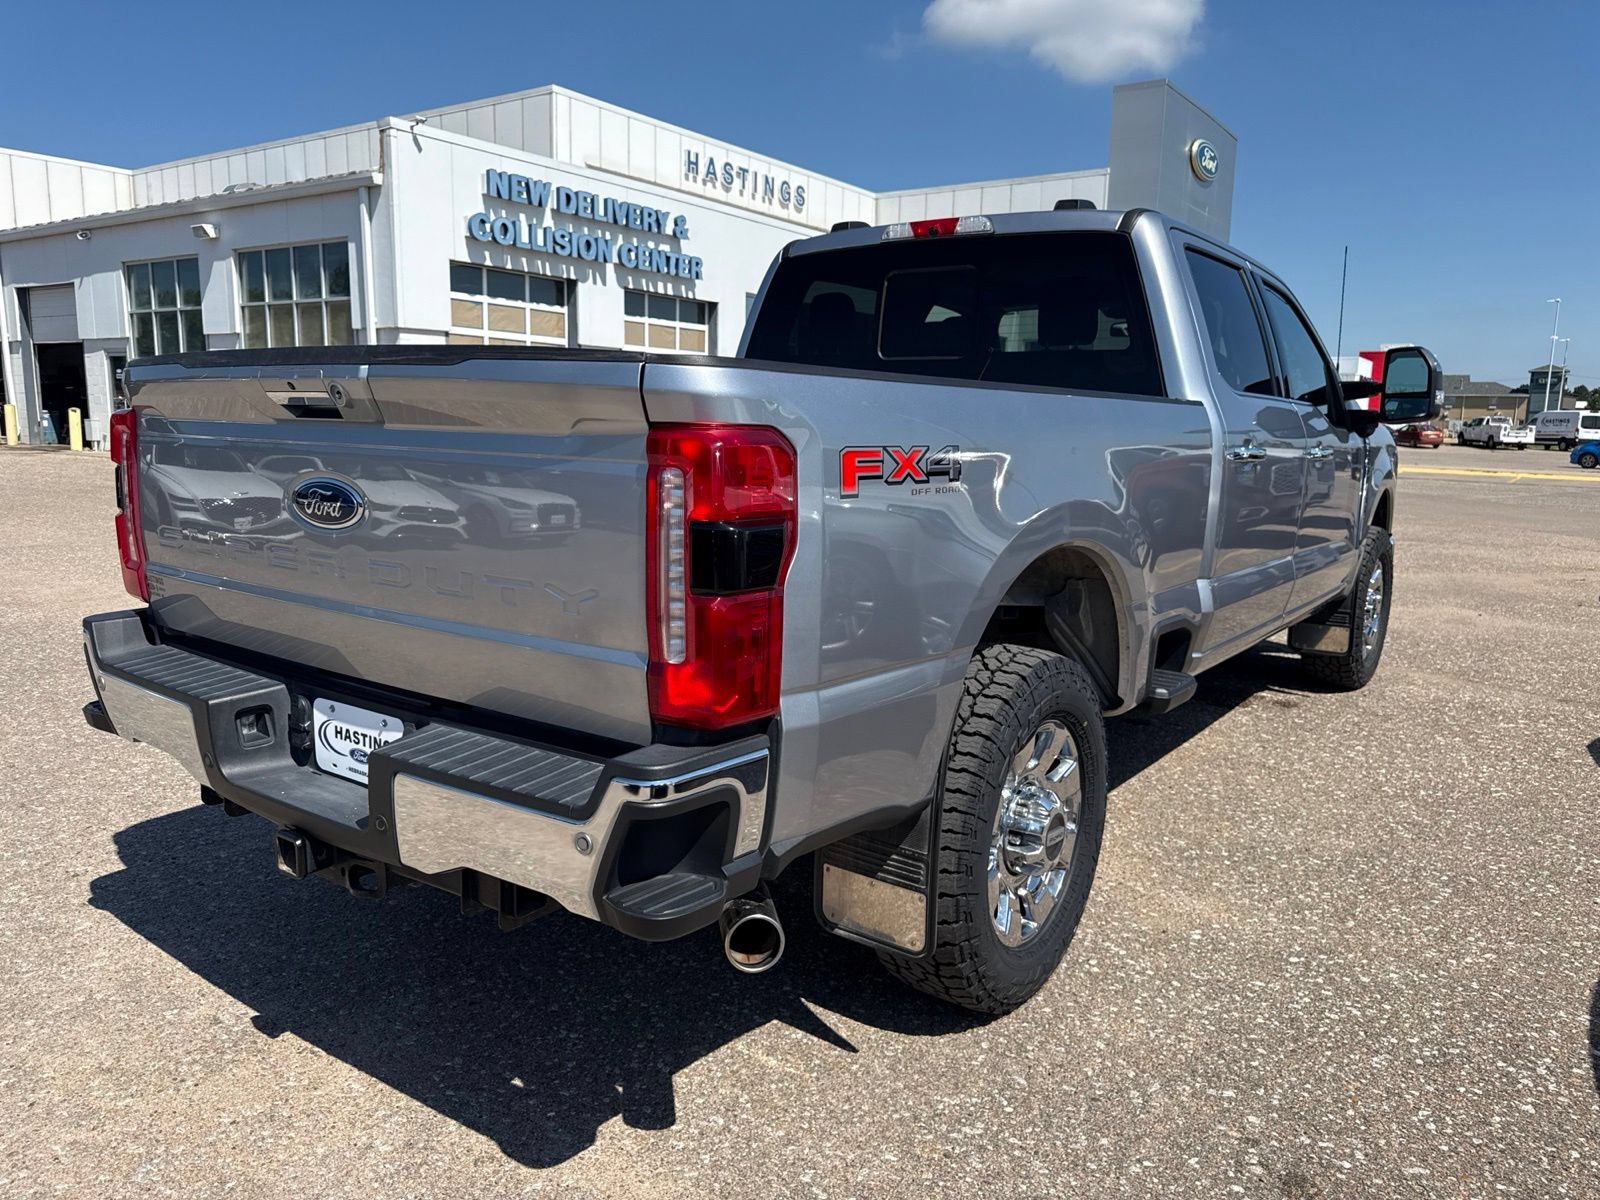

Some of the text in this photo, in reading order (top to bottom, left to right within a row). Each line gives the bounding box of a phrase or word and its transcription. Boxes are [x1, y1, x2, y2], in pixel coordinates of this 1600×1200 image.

[486, 168, 690, 241] NEW DELIVERY &
[686, 150, 806, 207] HASTINGS
[468, 212, 703, 281] COLLISION CENTER
[839, 445, 962, 500] FX4
[911, 486, 961, 496] OFF ROAD
[303, 487, 343, 518] Ford
[156, 525, 600, 617] SUPER DUTY
